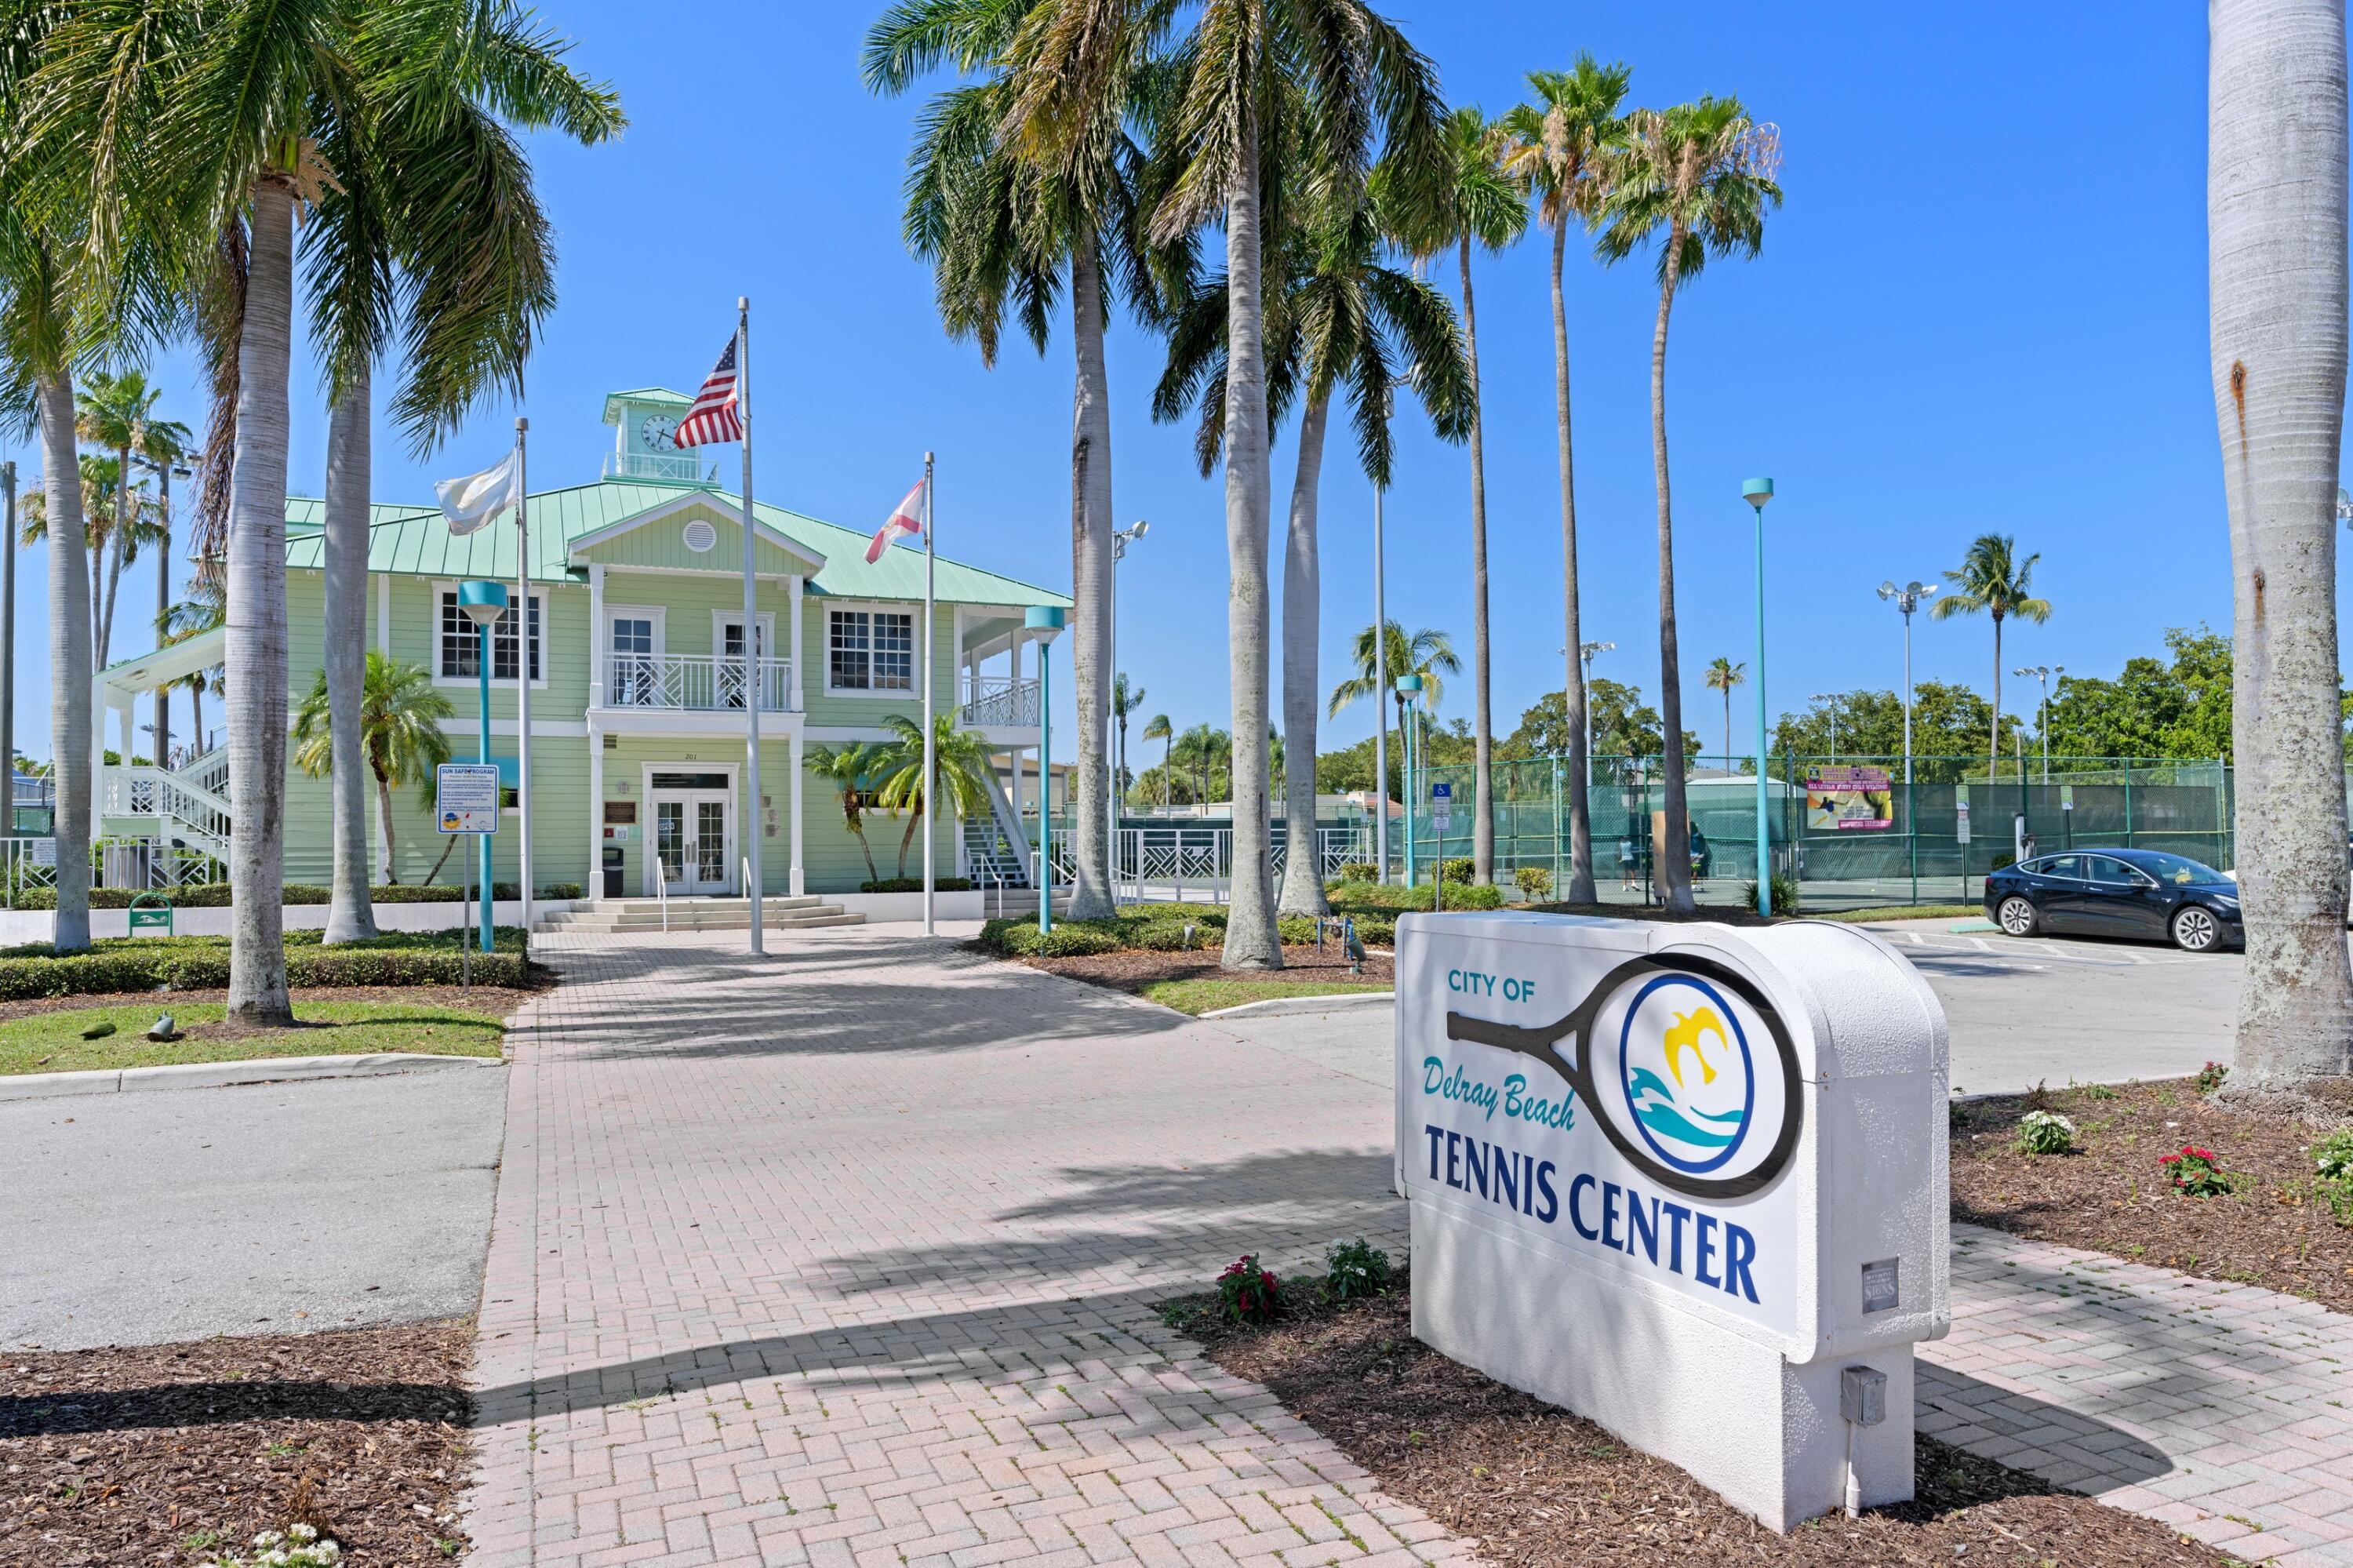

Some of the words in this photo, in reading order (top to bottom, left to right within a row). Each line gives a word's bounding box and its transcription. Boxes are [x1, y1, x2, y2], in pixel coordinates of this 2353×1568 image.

[1448, 969, 1497, 997] CITY
[1503, 978, 1535, 1002] OF
[1424, 1056, 1499, 1122] Delray
[1504, 1073, 1575, 1131] Beach
[1425, 1124, 1558, 1224] TENNIS
[1569, 1173, 1761, 1304] CENTER
[1866, 1281, 1895, 1300] SIGNS
